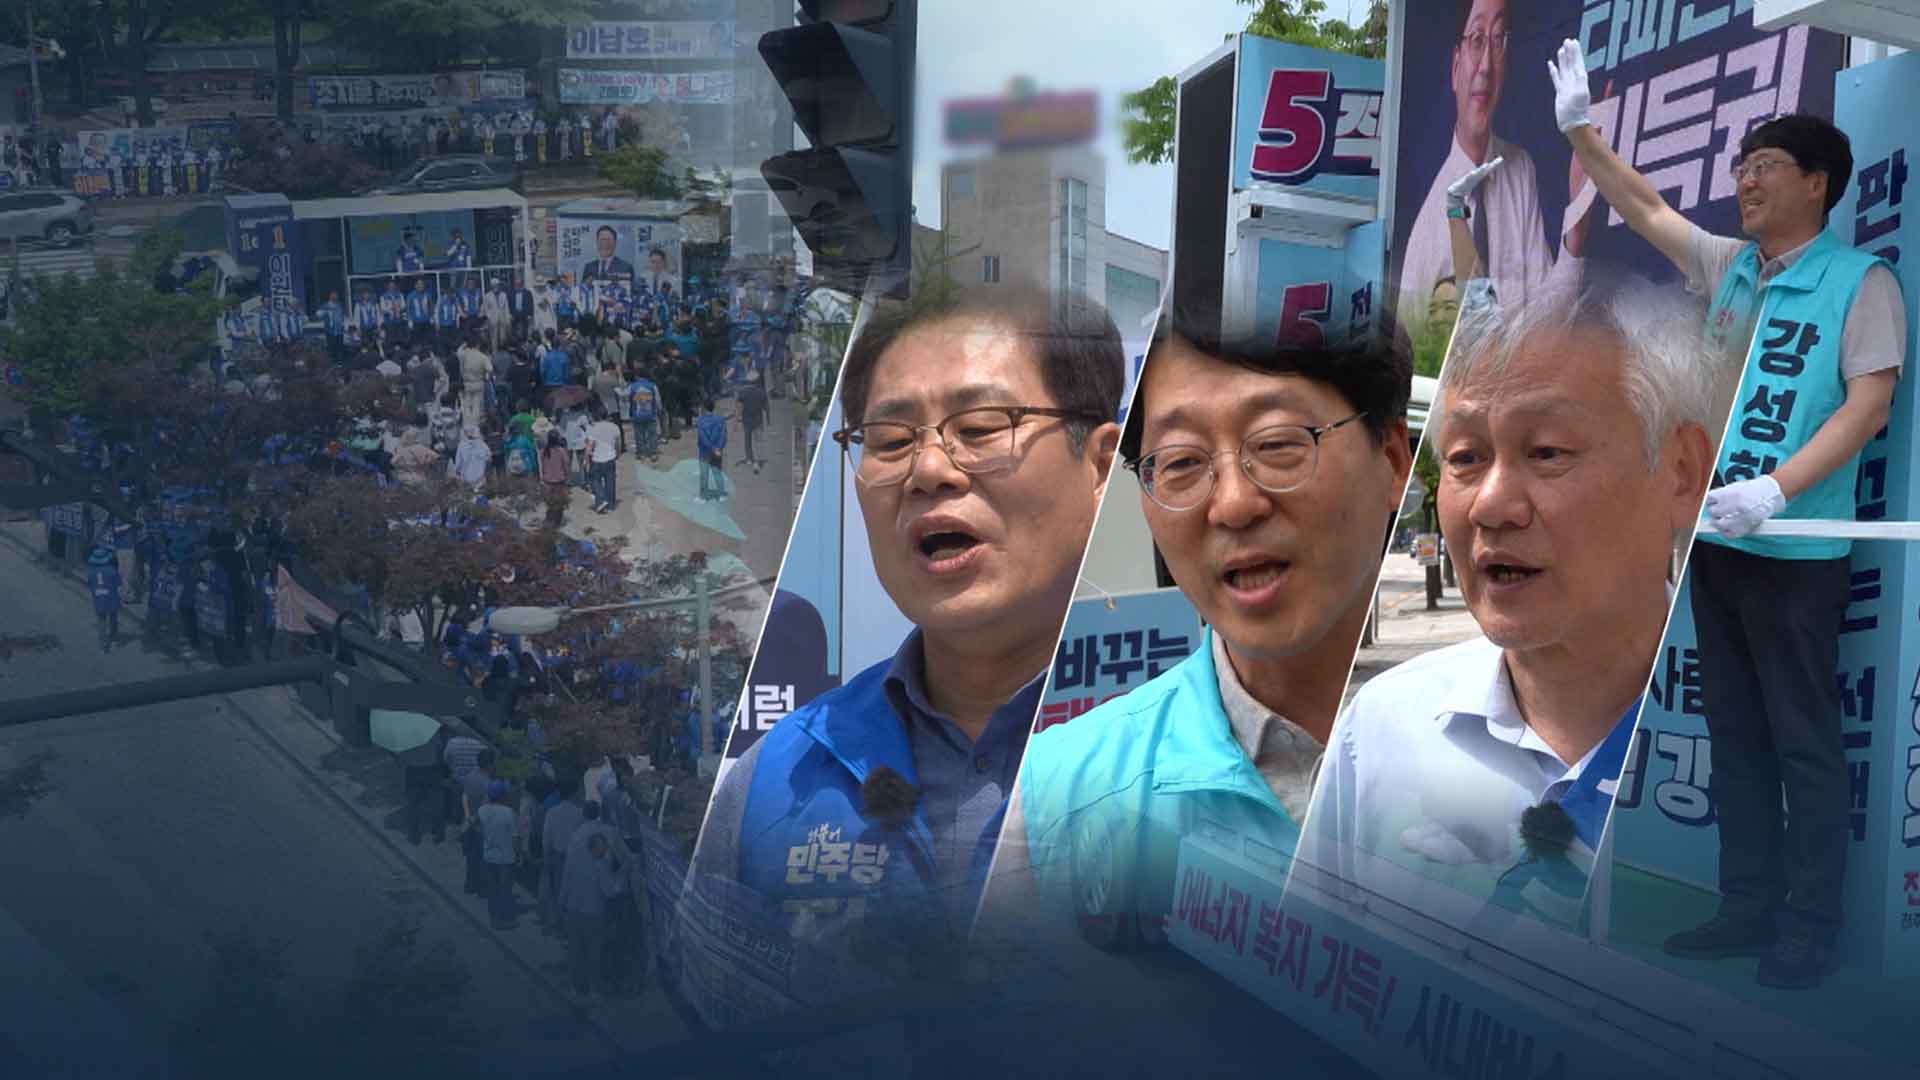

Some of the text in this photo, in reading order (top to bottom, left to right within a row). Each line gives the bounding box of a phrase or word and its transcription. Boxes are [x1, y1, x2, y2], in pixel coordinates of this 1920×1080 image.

[573, 25, 651, 55] 이남호
[1250, 69, 1332, 181] 5
[1054, 628, 1190, 691] 바꾸는
[783, 841, 889, 886] 민주당
[1176, 865, 1251, 957] 에너지
[1253, 899, 1313, 993] 복지
[1314, 936, 1399, 1037] 가득!
